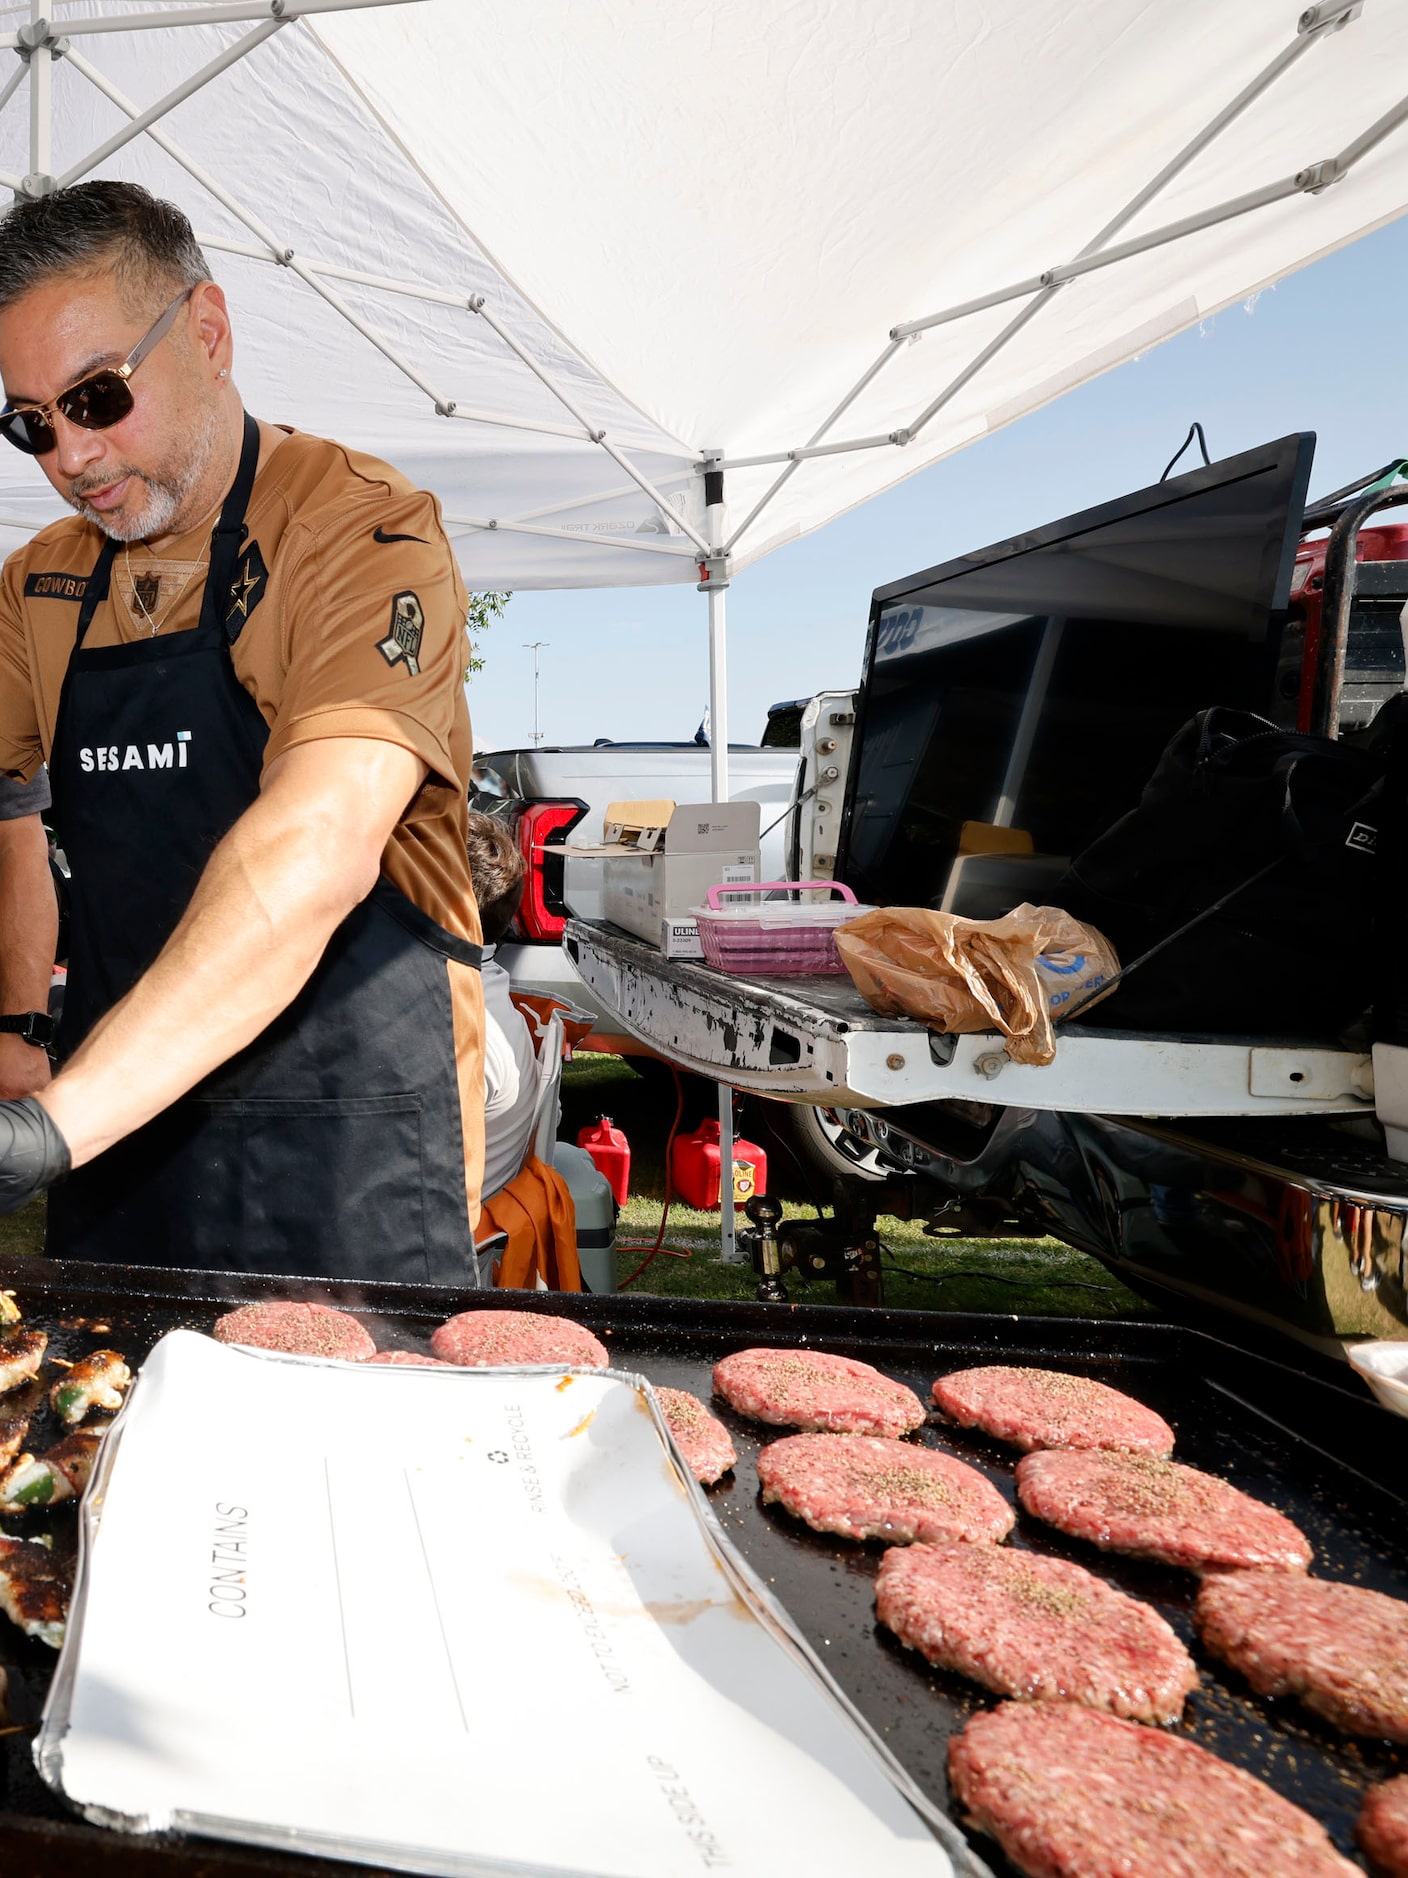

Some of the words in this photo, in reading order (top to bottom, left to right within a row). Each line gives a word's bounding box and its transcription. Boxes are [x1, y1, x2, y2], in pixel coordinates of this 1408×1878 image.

[34, 576, 88, 598] COWBO
[396, 624, 418, 655] NFL
[734, 1169, 753, 1178] OLINE
[504, 1404, 533, 1461] RECYCLE
[520, 1465, 537, 1474] &
[522, 1477, 548, 1514] RINSE
[208, 1501, 248, 1619] CONTAINS
[600, 1663, 634, 1695] NOT
[646, 1754, 680, 1781] UP
[660, 1785, 706, 1827] SIDE
[687, 1828, 733, 1868] THIS
